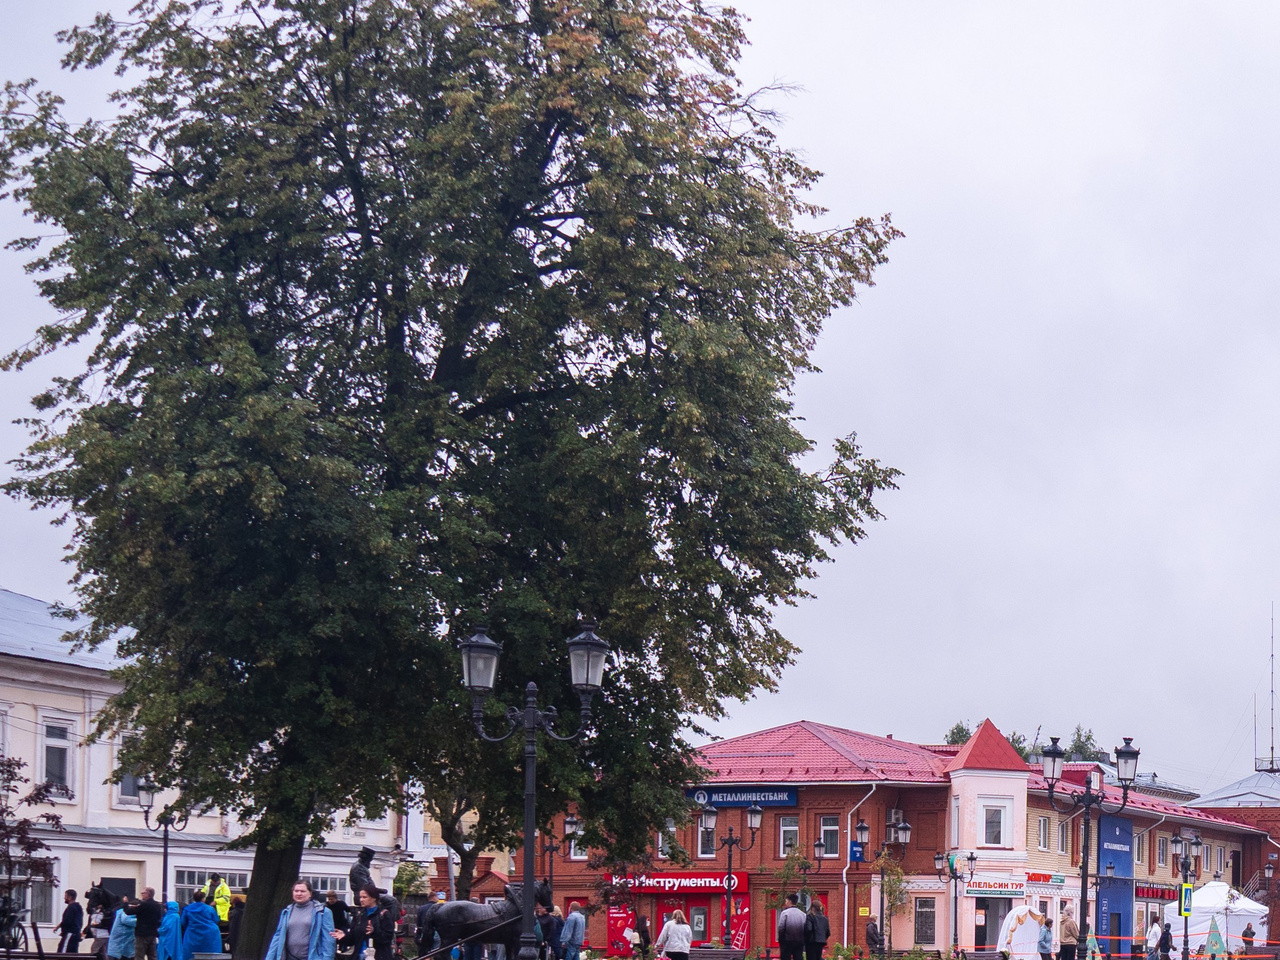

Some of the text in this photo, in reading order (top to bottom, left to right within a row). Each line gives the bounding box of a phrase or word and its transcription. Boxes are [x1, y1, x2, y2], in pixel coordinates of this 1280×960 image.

[711, 792, 789, 802] МЕТАЛЛИНВЕСТБАНК
[967, 881, 1024, 890] АПЕЛЬСИН ТУР
